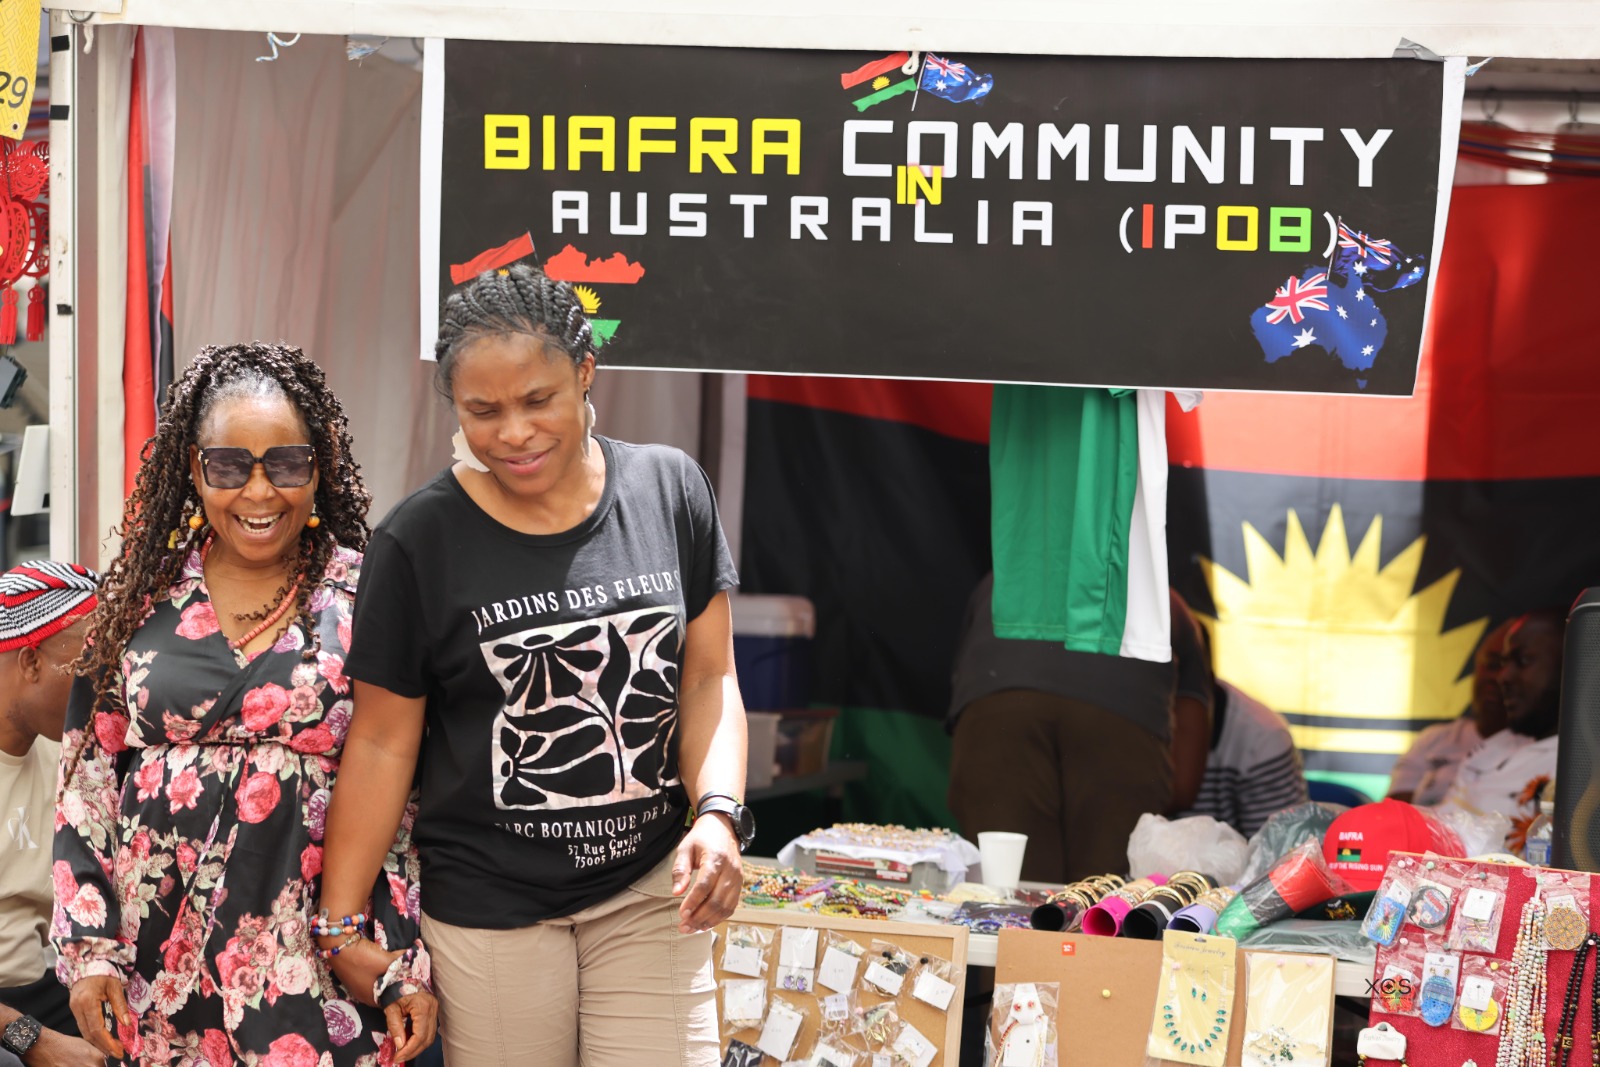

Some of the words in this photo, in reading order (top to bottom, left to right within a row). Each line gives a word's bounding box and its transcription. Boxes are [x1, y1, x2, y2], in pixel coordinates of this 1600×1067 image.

[484, 114, 801, 175] BIAFRA
[843, 119, 1393, 187] COMMUNITY
[897, 165, 942, 205] IN
[552, 190, 1052, 246] AUSTRALIA
[1119, 204, 1338, 258] (IPOB)
[471, 591, 560, 636] JARDINS
[565, 584, 608, 610] DES
[494, 822, 535, 838] ARC
[541, 814, 637, 839] BOTANIQUE
[642, 806, 659, 824] DE
[567, 844, 579, 856] 57
[583, 843, 605, 855] Rue
[609, 832, 642, 851] Cuvier
[574, 855, 606, 868] 75005
[610, 845, 636, 860] Paris
[1369, 864, 1384, 872] SUN
